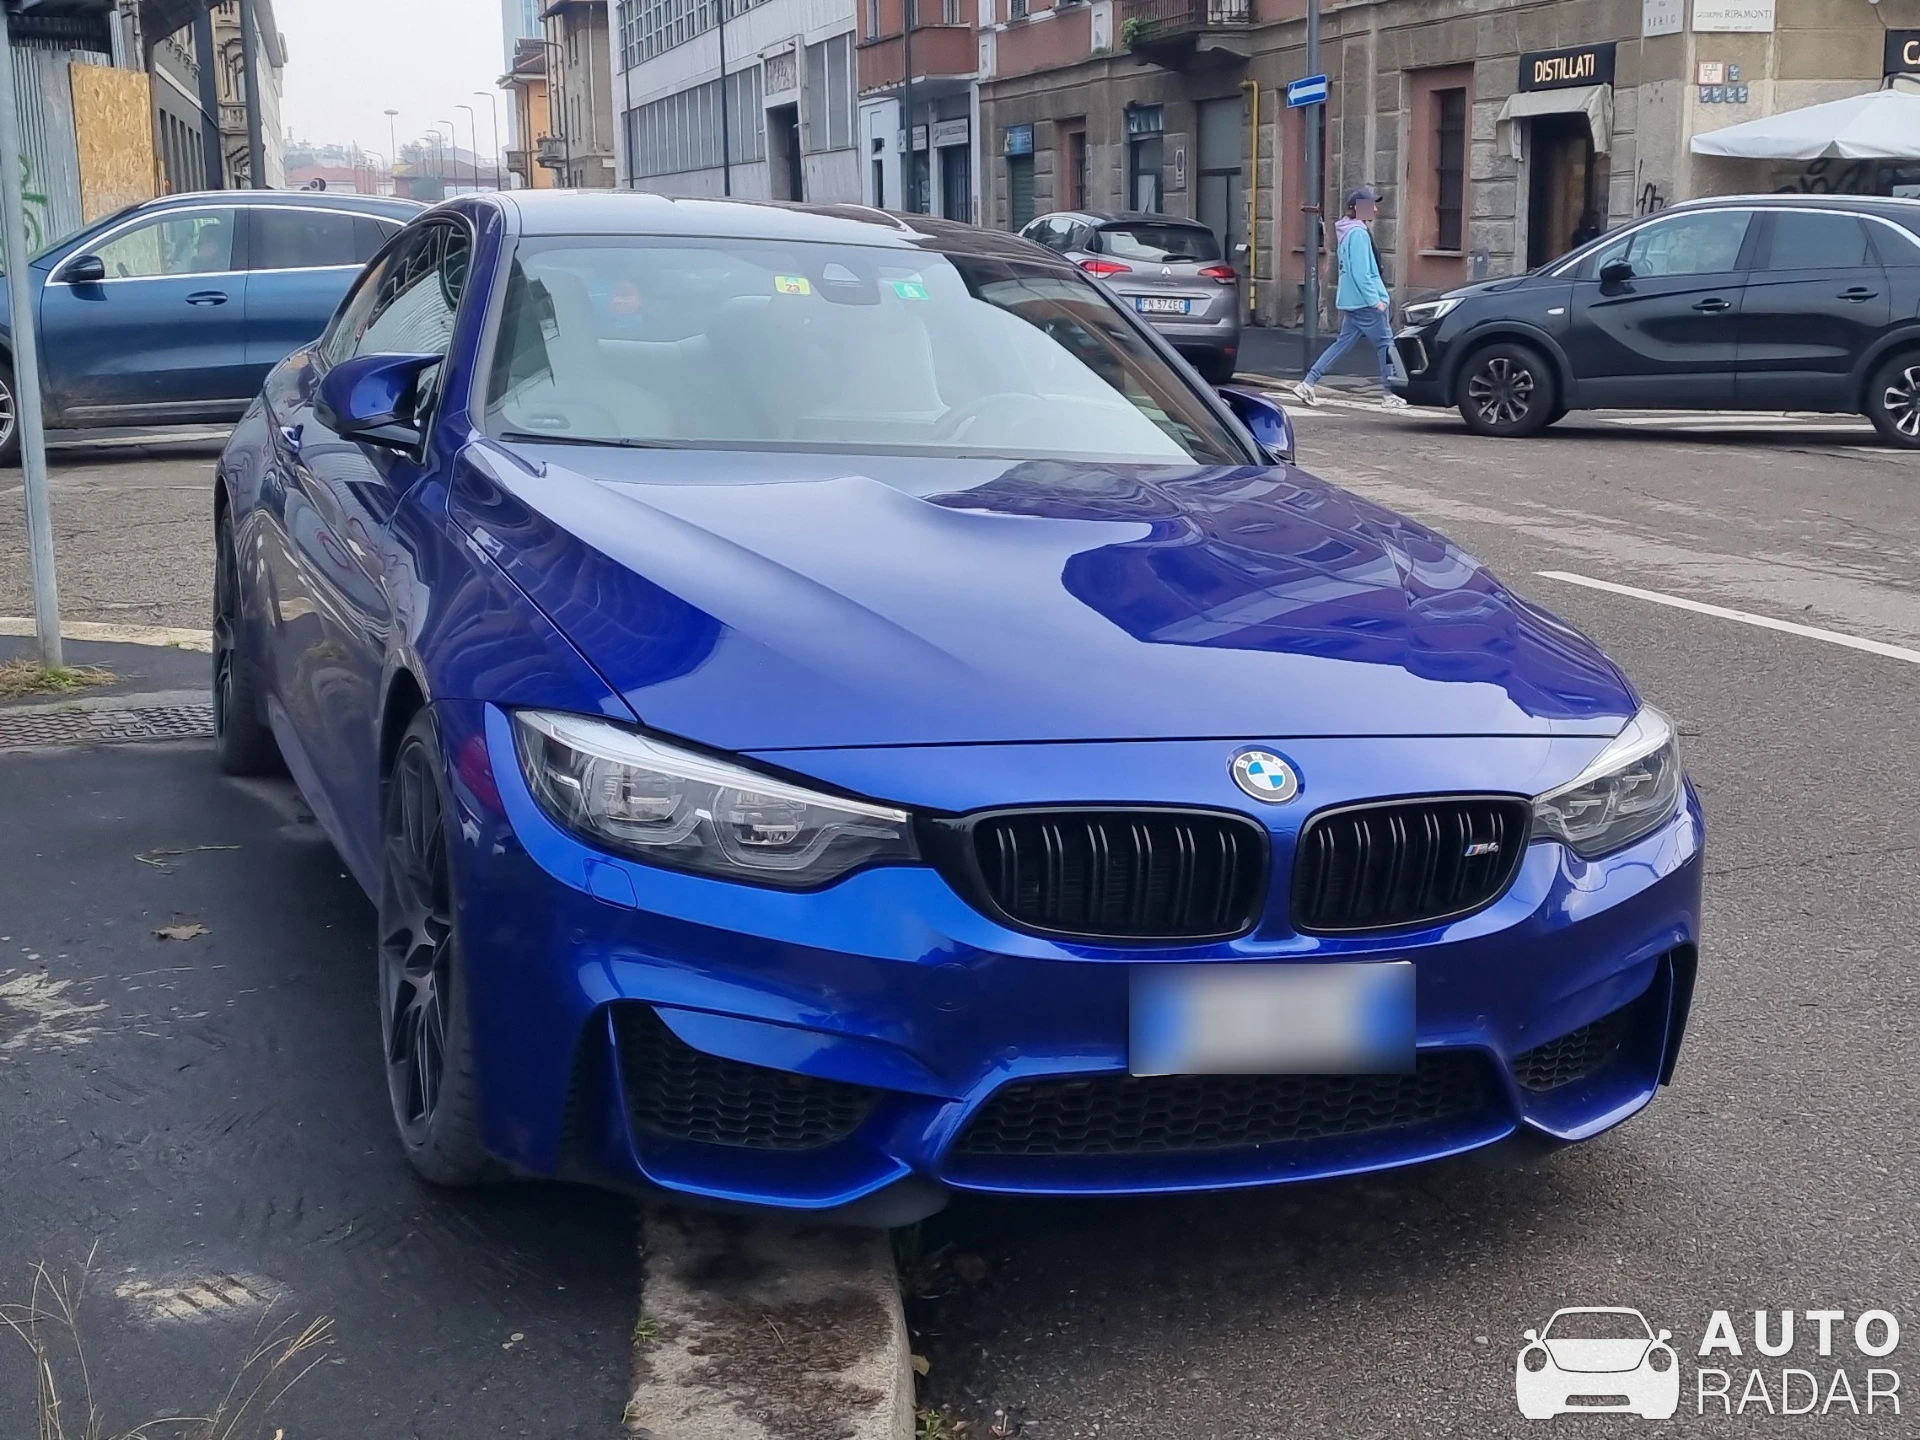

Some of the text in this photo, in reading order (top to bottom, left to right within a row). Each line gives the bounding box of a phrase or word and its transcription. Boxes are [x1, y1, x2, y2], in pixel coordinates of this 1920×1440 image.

[1724, 9, 1772, 19] RIPAMONTI
[1903, 40, 1920, 65] C
[1534, 53, 1595, 83] DISTILLATI
[1143, 299, 1184, 310] FN 374EC
[1236, 752, 1285, 769] BMW
